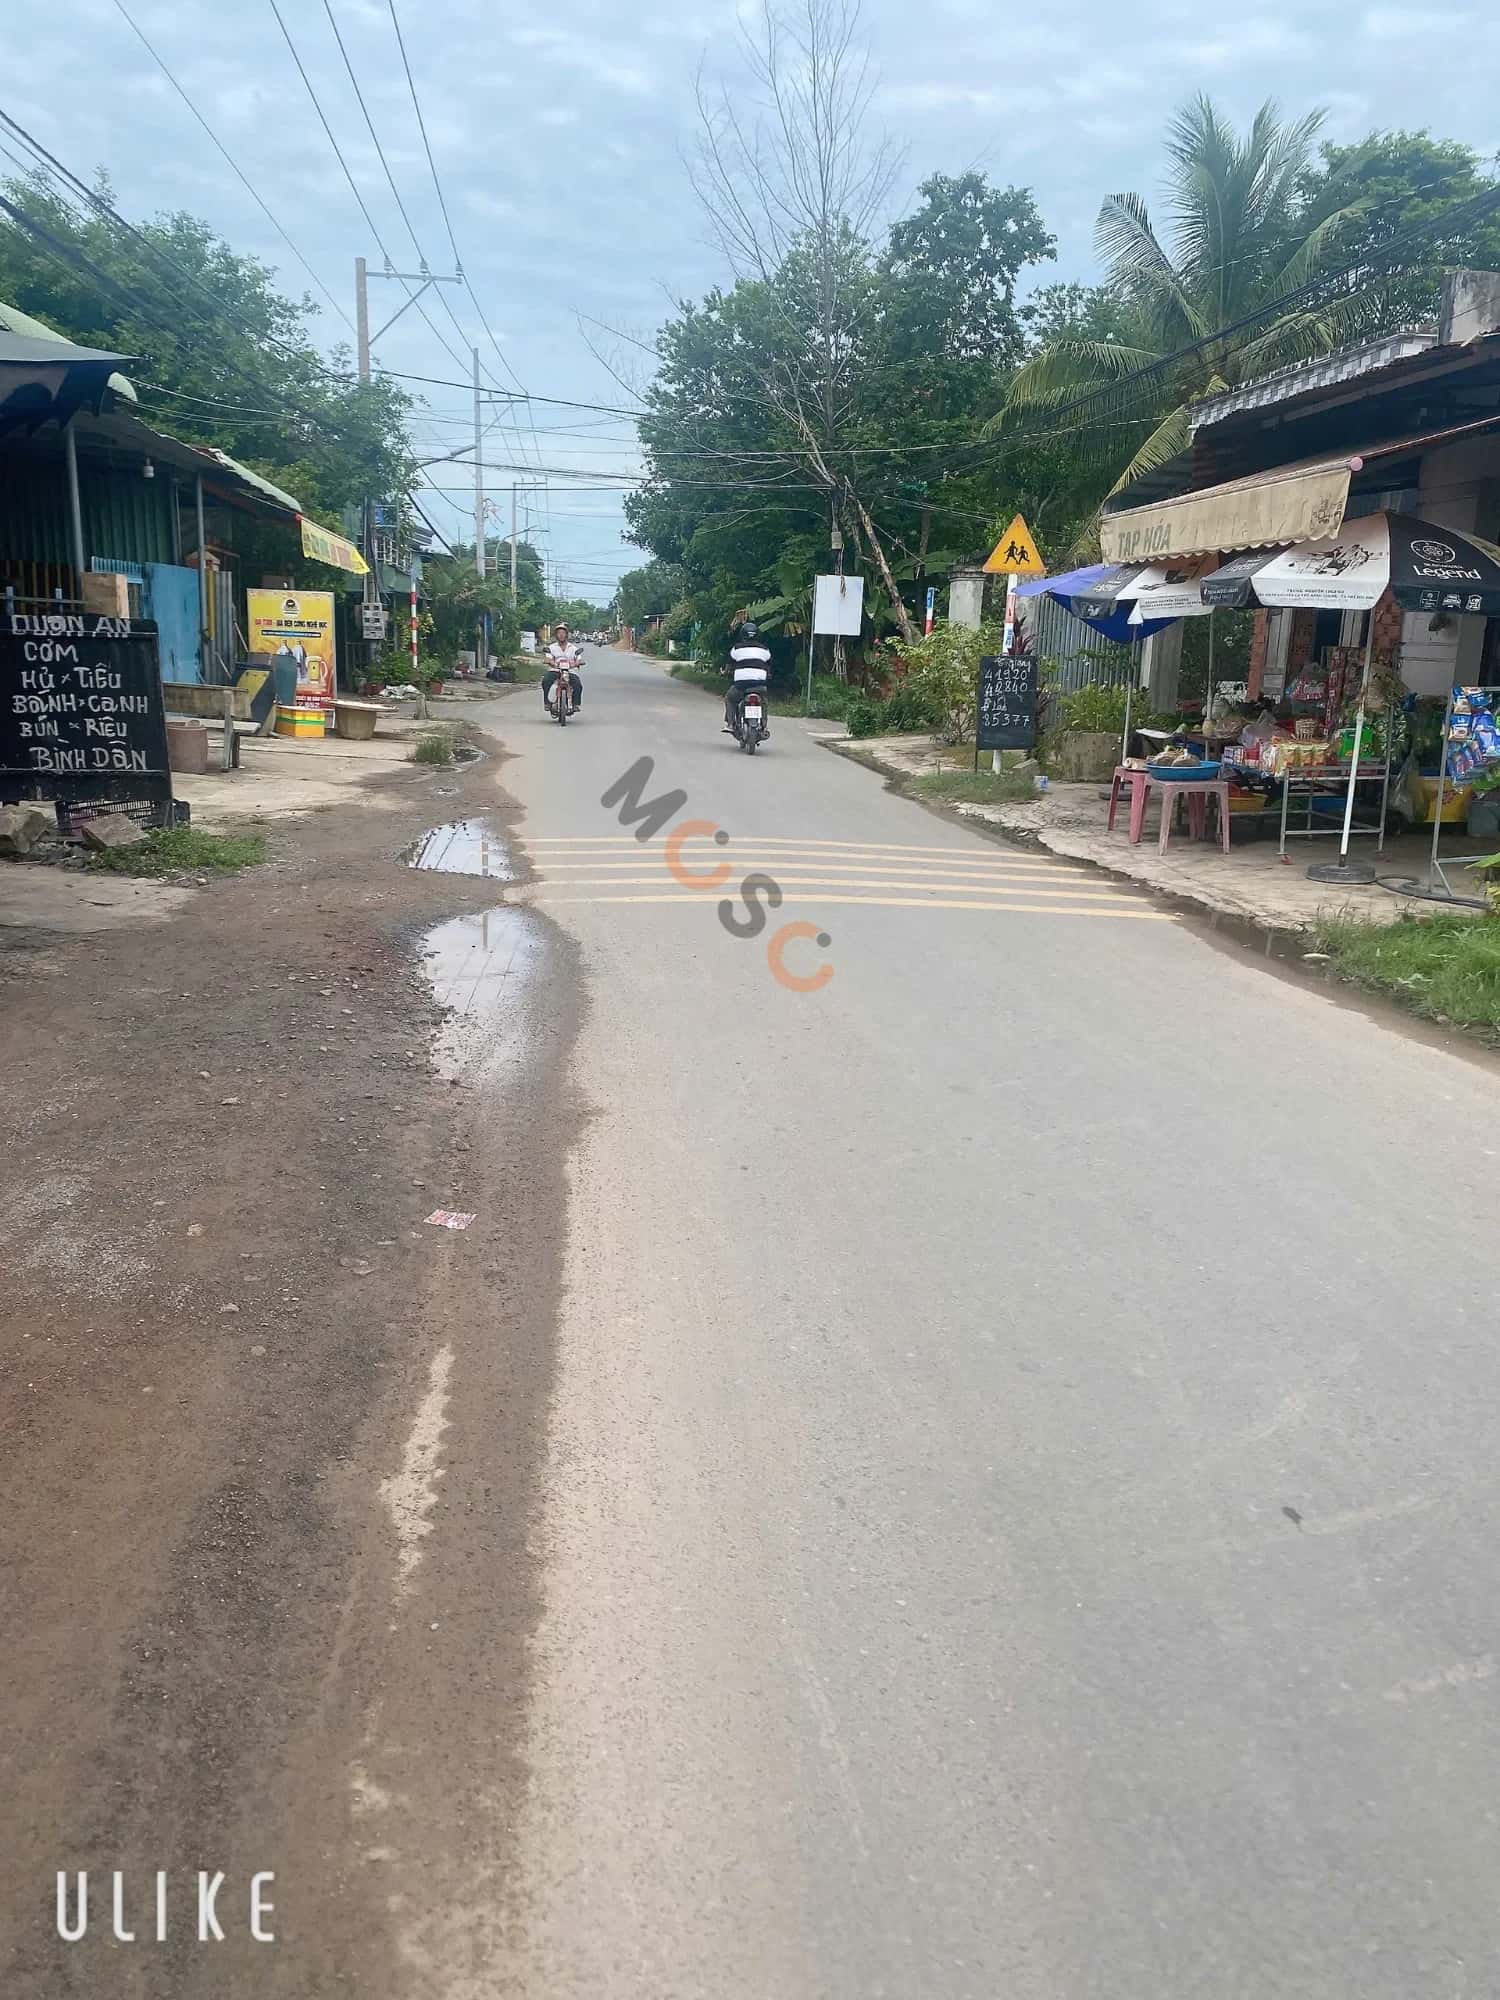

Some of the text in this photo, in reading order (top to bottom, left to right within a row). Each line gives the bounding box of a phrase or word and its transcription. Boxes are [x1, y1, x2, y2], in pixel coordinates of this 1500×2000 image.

[1413, 565, 1482, 580] Legend
[23, 638, 79, 662] CƠM
[88, 695, 148, 713] CANH
[19, 715, 58, 736] BÚN
[92, 740, 147, 770] DÂN
